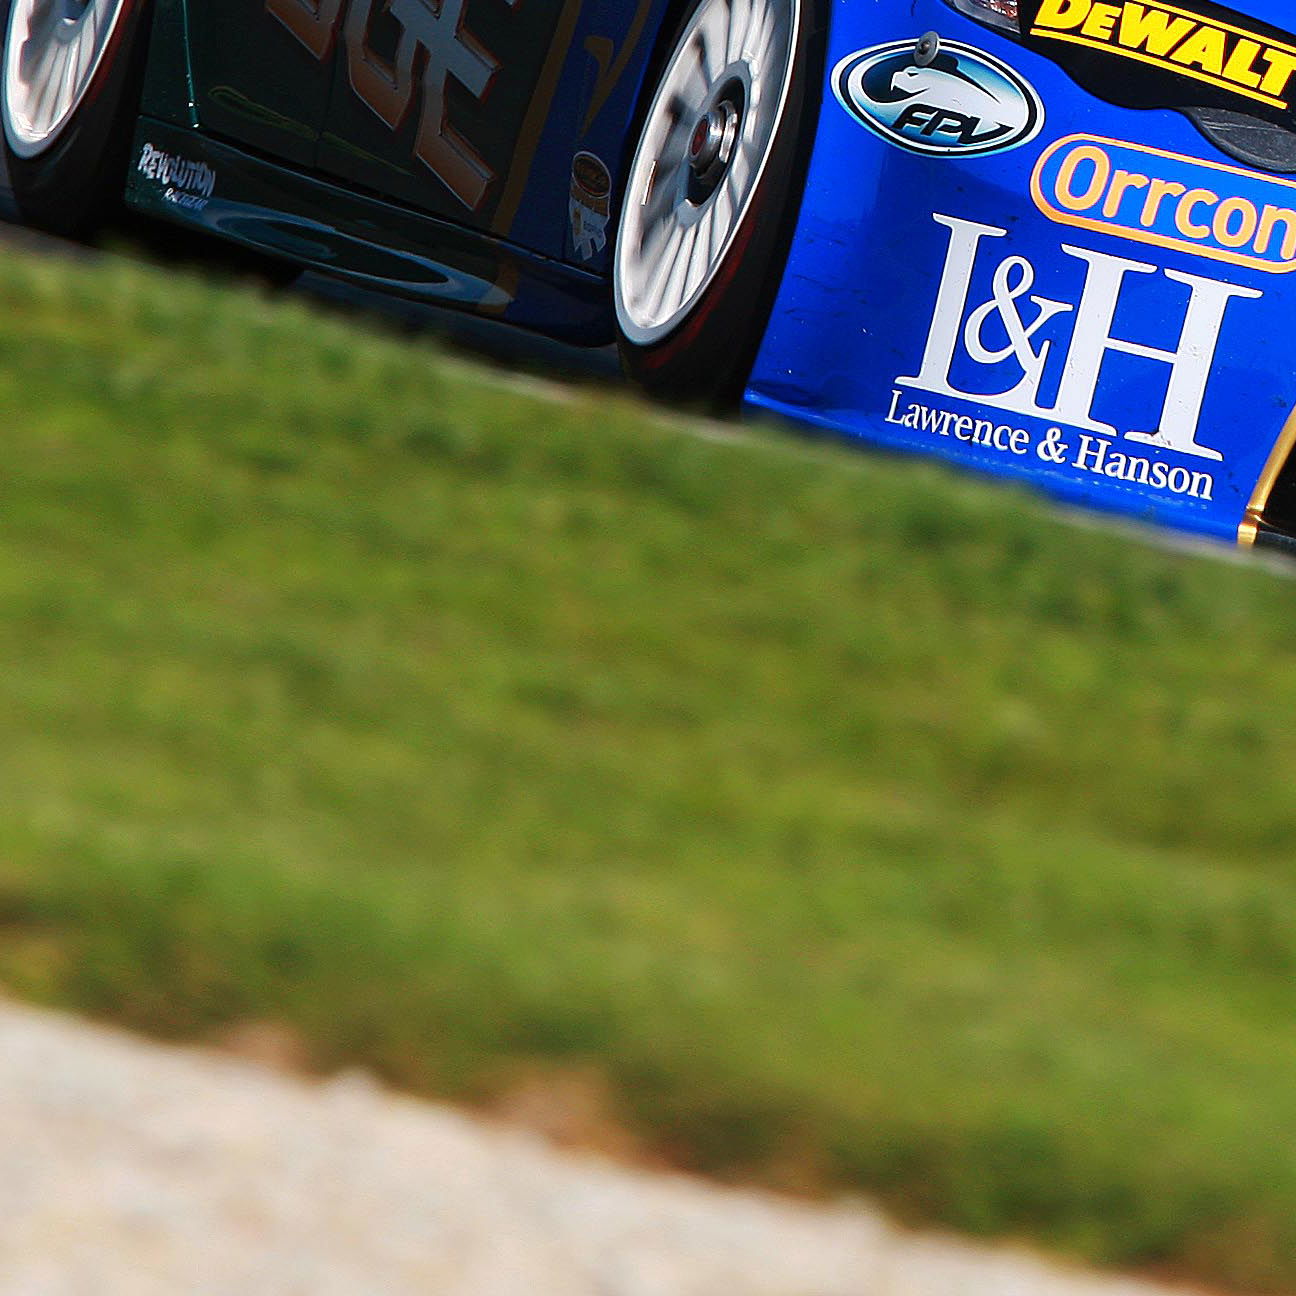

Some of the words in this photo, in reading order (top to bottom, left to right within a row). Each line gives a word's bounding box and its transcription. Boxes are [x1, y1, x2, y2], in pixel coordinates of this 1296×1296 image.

[893, 102, 1014, 145] FPV
[894, 212, 1264, 462] L&H
[884, 390, 1031, 455] Lawrence
[1036, 429, 1068, 464] &
[1072, 434, 1214, 501] Hanson
